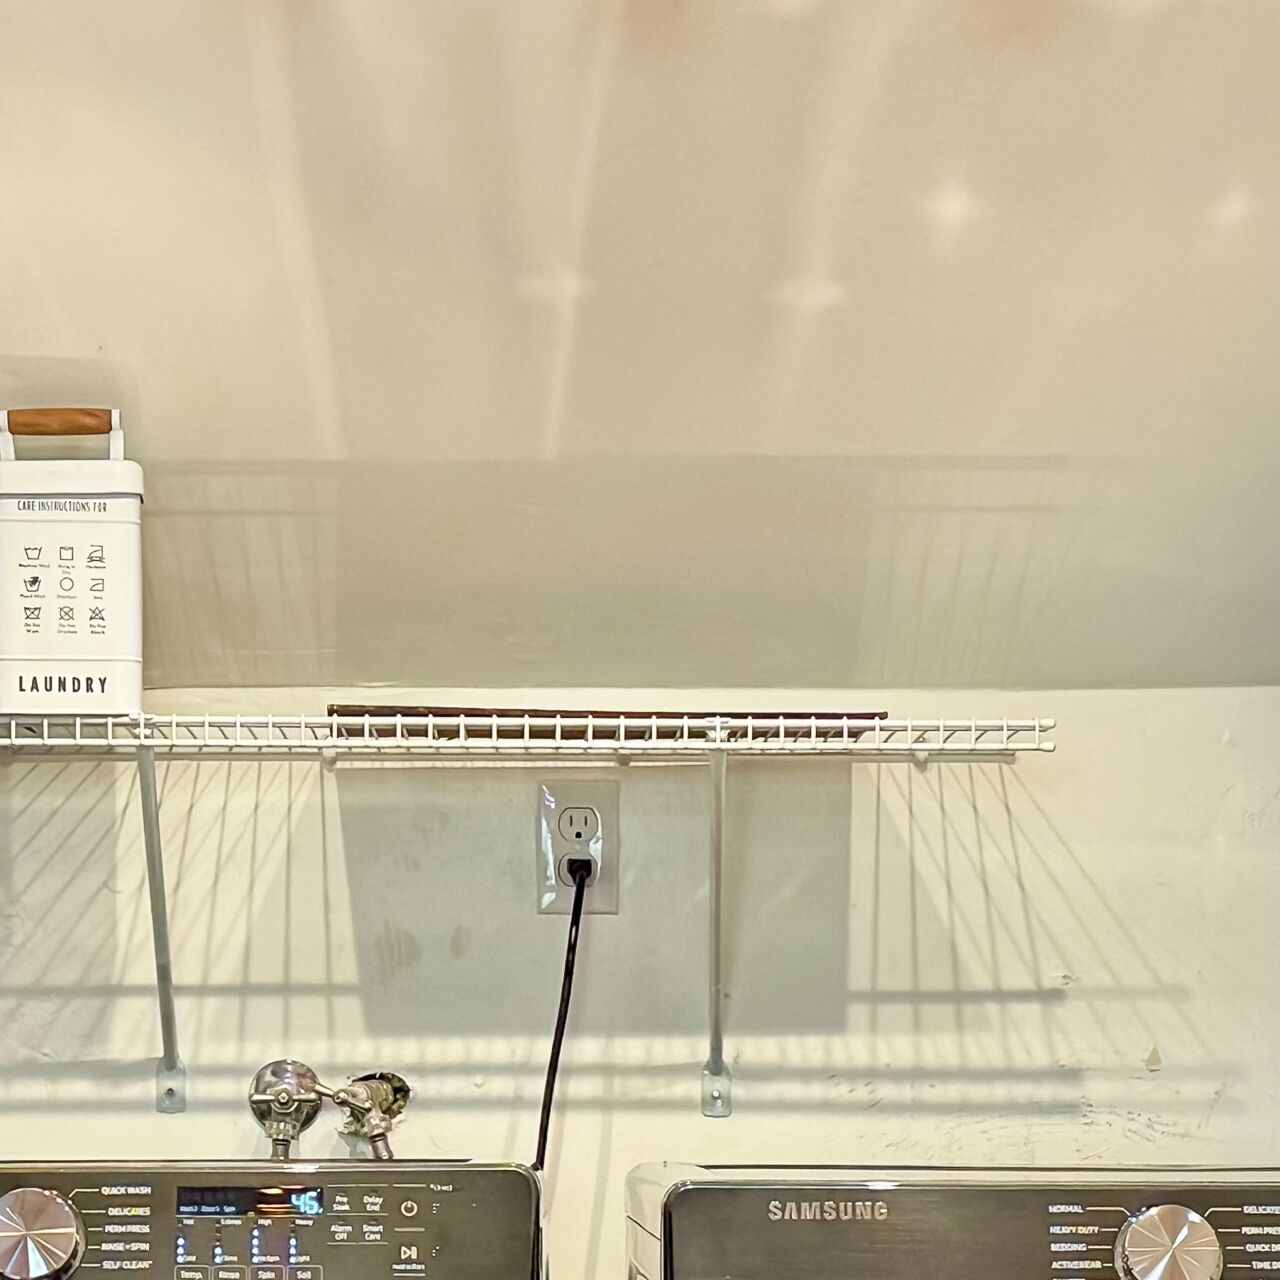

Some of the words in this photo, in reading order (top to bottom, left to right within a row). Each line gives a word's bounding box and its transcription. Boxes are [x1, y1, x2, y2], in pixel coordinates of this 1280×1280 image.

[17, 500, 35, 511] CARE
[38, 501, 91, 512] INSTRUCTIONS
[93, 502, 107, 512] FOR
[19, 675, 107, 694] LAUNDRY
[101, 1186, 126, 1195] QUICK
[127, 1186, 151, 1195] WASH
[335, 1195, 348, 1203] Pre
[363, 1195, 384, 1204] Delay
[107, 1206, 151, 1216] DELICATES
[366, 1203, 381, 1212] End
[768, 1200, 888, 1221] SAMSUNG
[1245, 1244, 1271, 1252] QUICK
[102, 1260, 120, 1269] SELF
[257, 1271, 275, 1280] Spin
[296, 1271, 311, 1280] Soil
